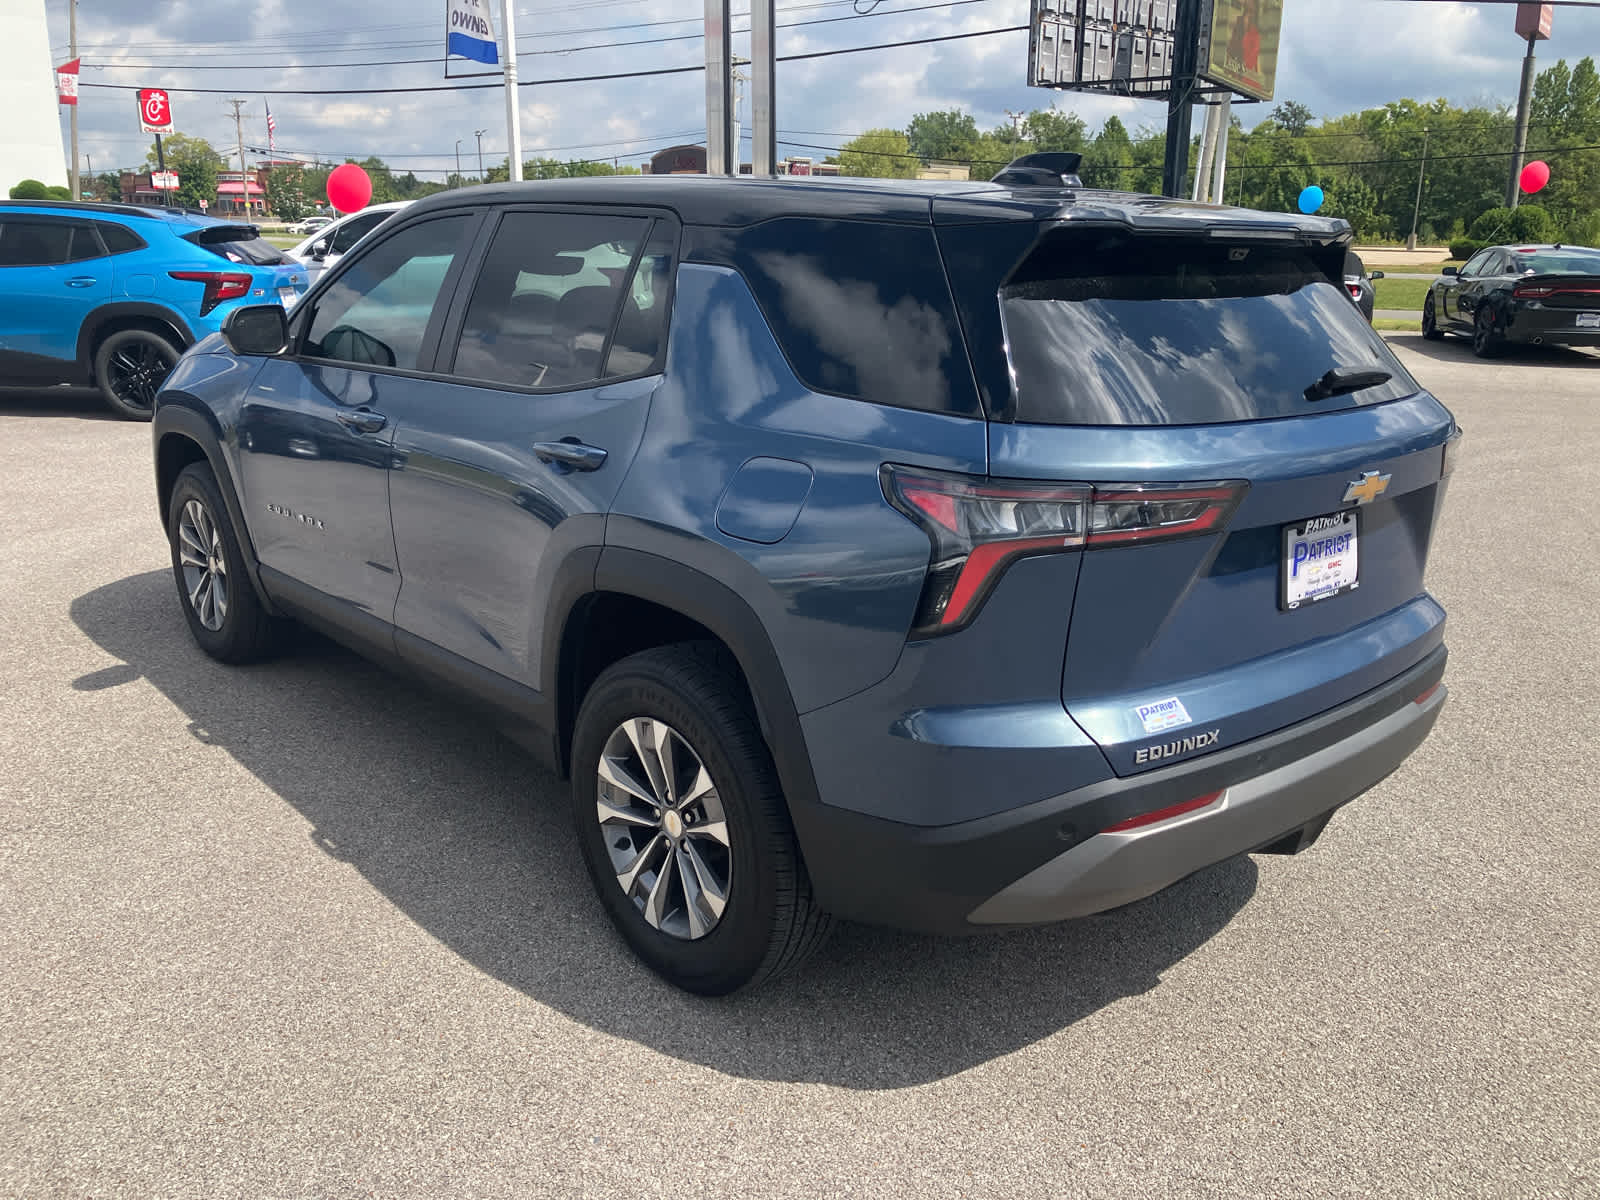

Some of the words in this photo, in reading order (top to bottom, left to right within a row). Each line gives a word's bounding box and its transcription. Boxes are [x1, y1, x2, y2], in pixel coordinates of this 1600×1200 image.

[266, 503, 324, 529] EQUINOX
[1305, 512, 1345, 535] PATRIOT
[1136, 729, 1219, 764] EQUINOX
